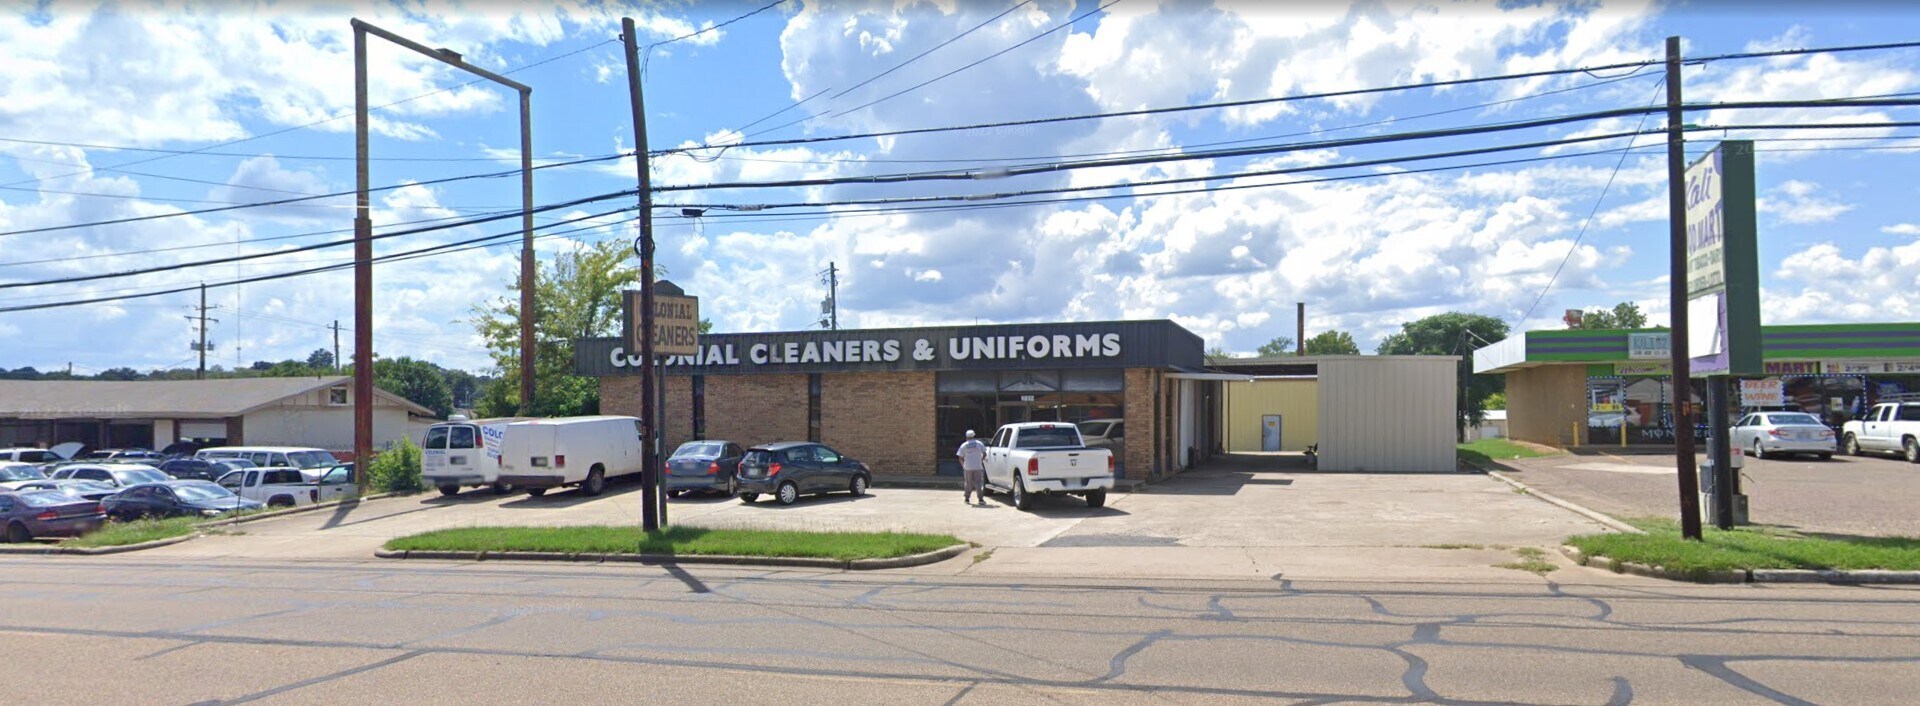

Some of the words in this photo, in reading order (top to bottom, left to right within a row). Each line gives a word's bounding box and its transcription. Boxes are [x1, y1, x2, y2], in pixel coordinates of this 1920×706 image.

[654, 302, 693, 319] LONIAL
[750, 340, 901, 364] CLEANERS
[913, 339, 936, 361] &
[950, 333, 1121, 360] UNIFORMS
[1765, 361, 1815, 374] MART
